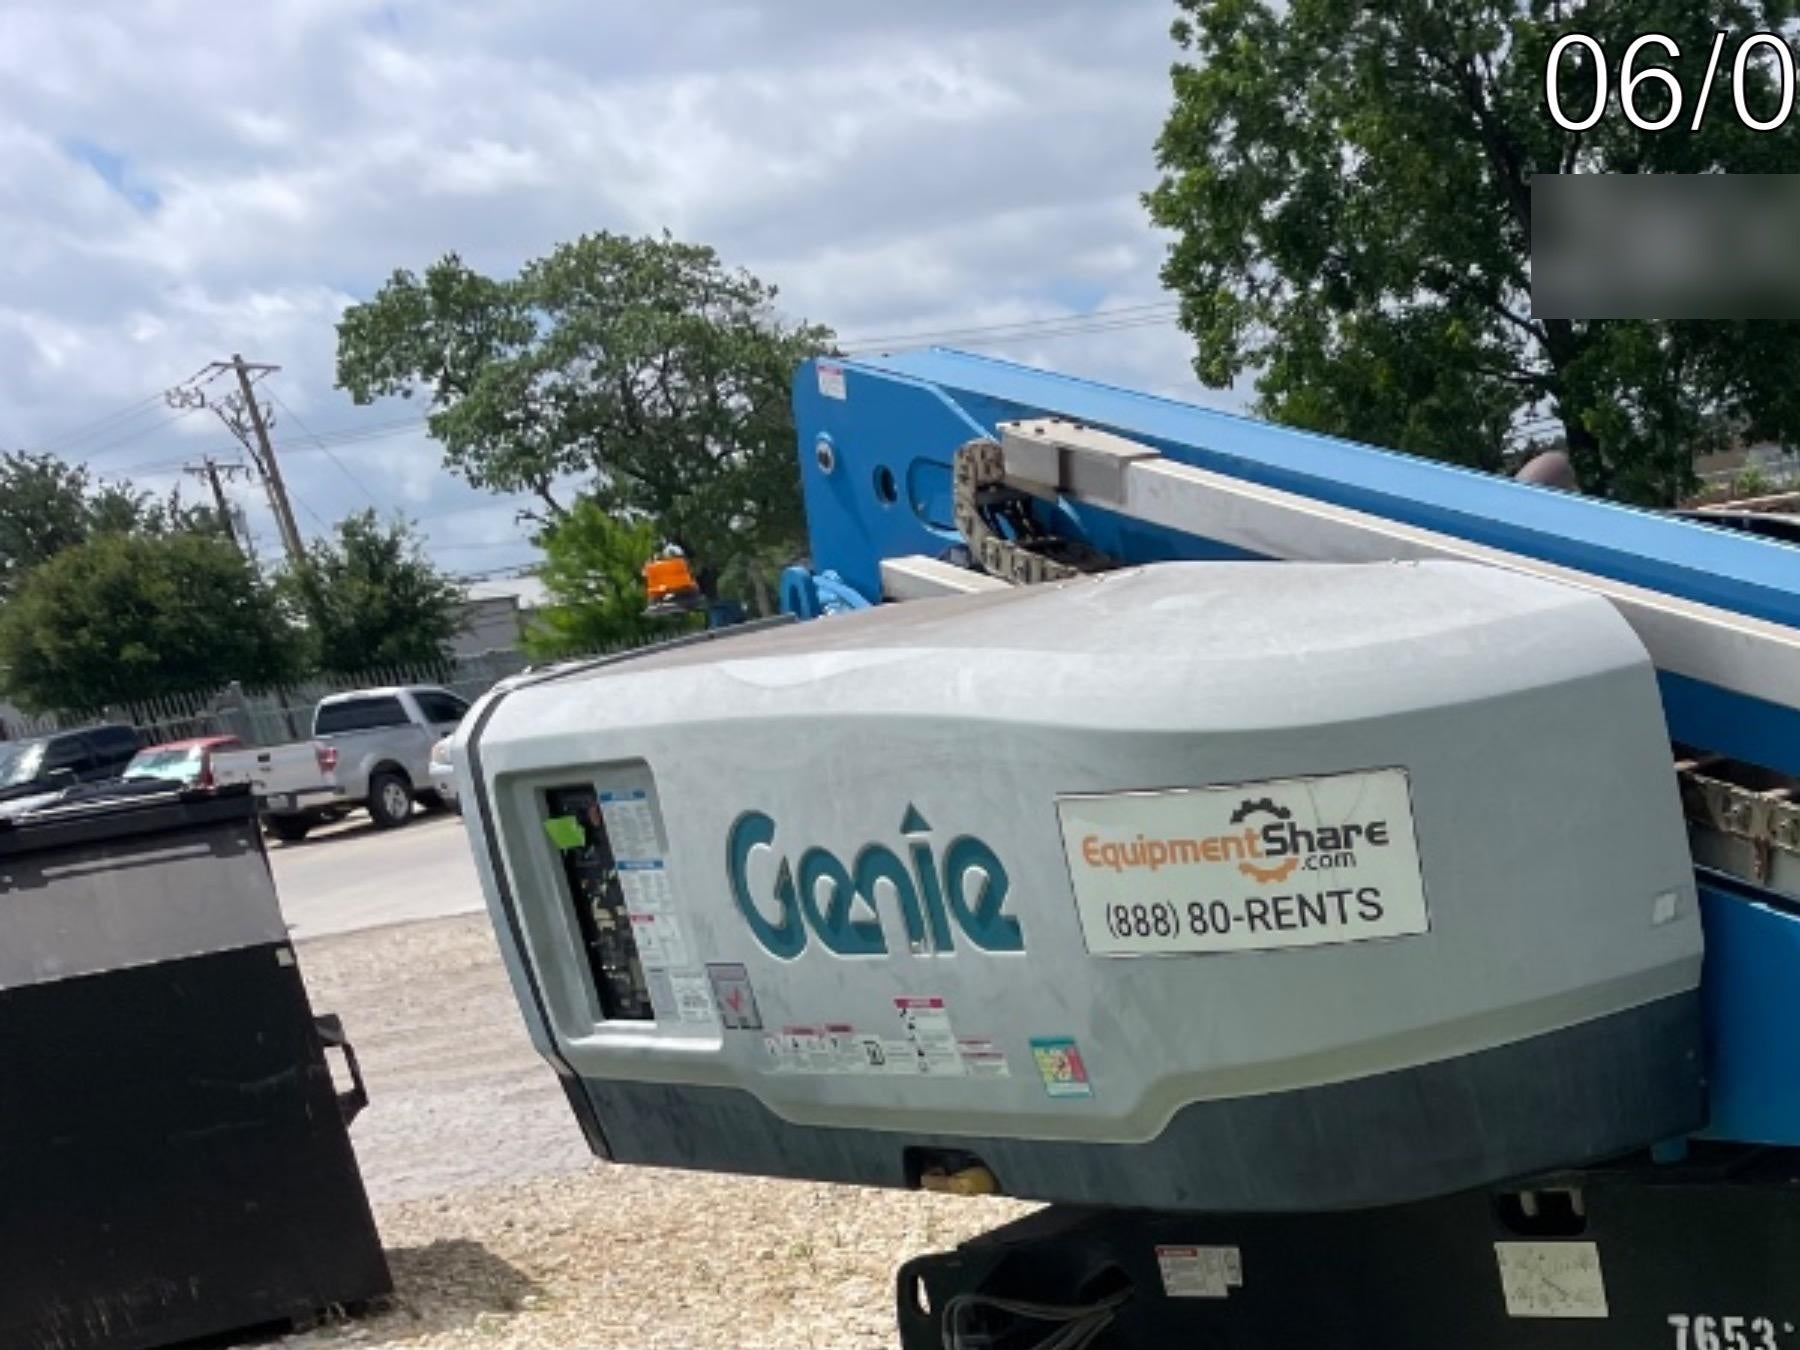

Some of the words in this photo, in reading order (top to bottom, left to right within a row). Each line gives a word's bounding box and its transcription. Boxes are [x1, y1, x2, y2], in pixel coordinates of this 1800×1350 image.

[1082, 821, 1389, 873] EquipmentShare
[1301, 852, 1357, 871] .com
[726, 801, 1027, 961] Genie
[1106, 899, 1181, 939] (888)
[1188, 887, 1384, 935] 80-RENTS
